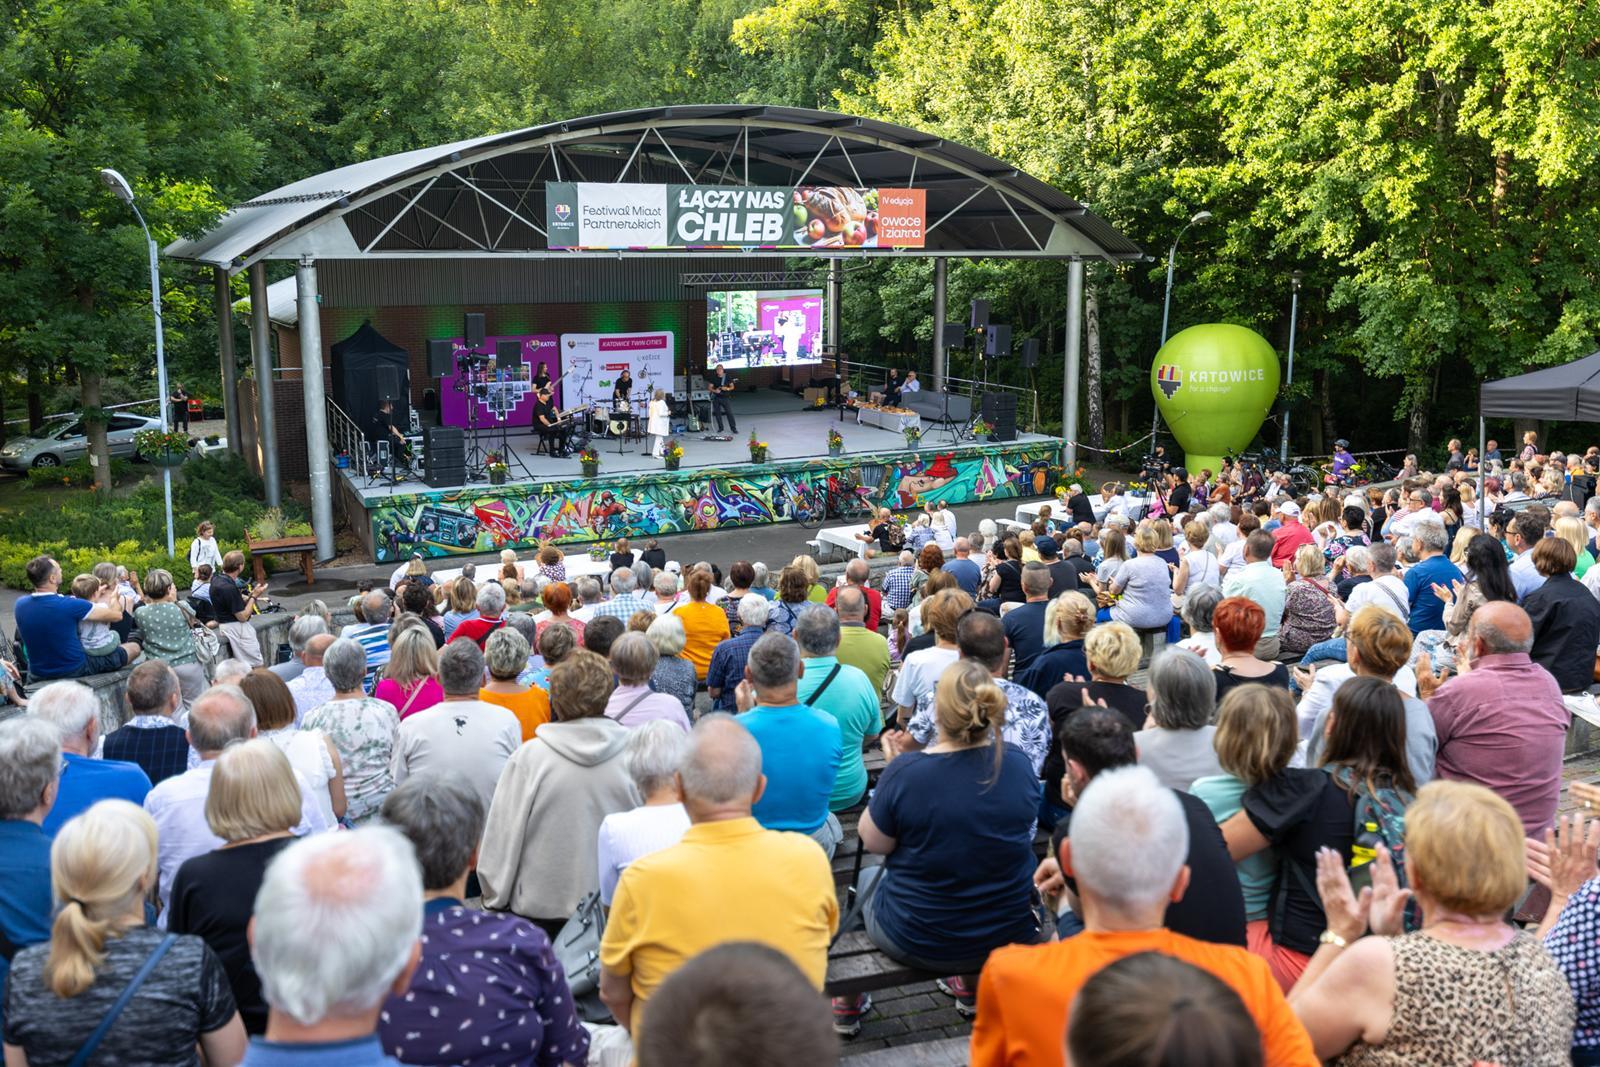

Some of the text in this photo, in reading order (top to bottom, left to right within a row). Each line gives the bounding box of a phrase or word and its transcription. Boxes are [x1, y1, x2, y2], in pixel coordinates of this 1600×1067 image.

[679, 190, 785, 213] ŁĄCZY NAS
[890, 197, 913, 206] edycja
[583, 205, 662, 216] Festiwal Miast
[583, 218, 662, 230] Partnerskich
[677, 212, 784, 242] CHLEB
[881, 217, 921, 227] owoce
[886, 228, 921, 238] ziarna
[1190, 369, 1265, 383] KATOWICE
